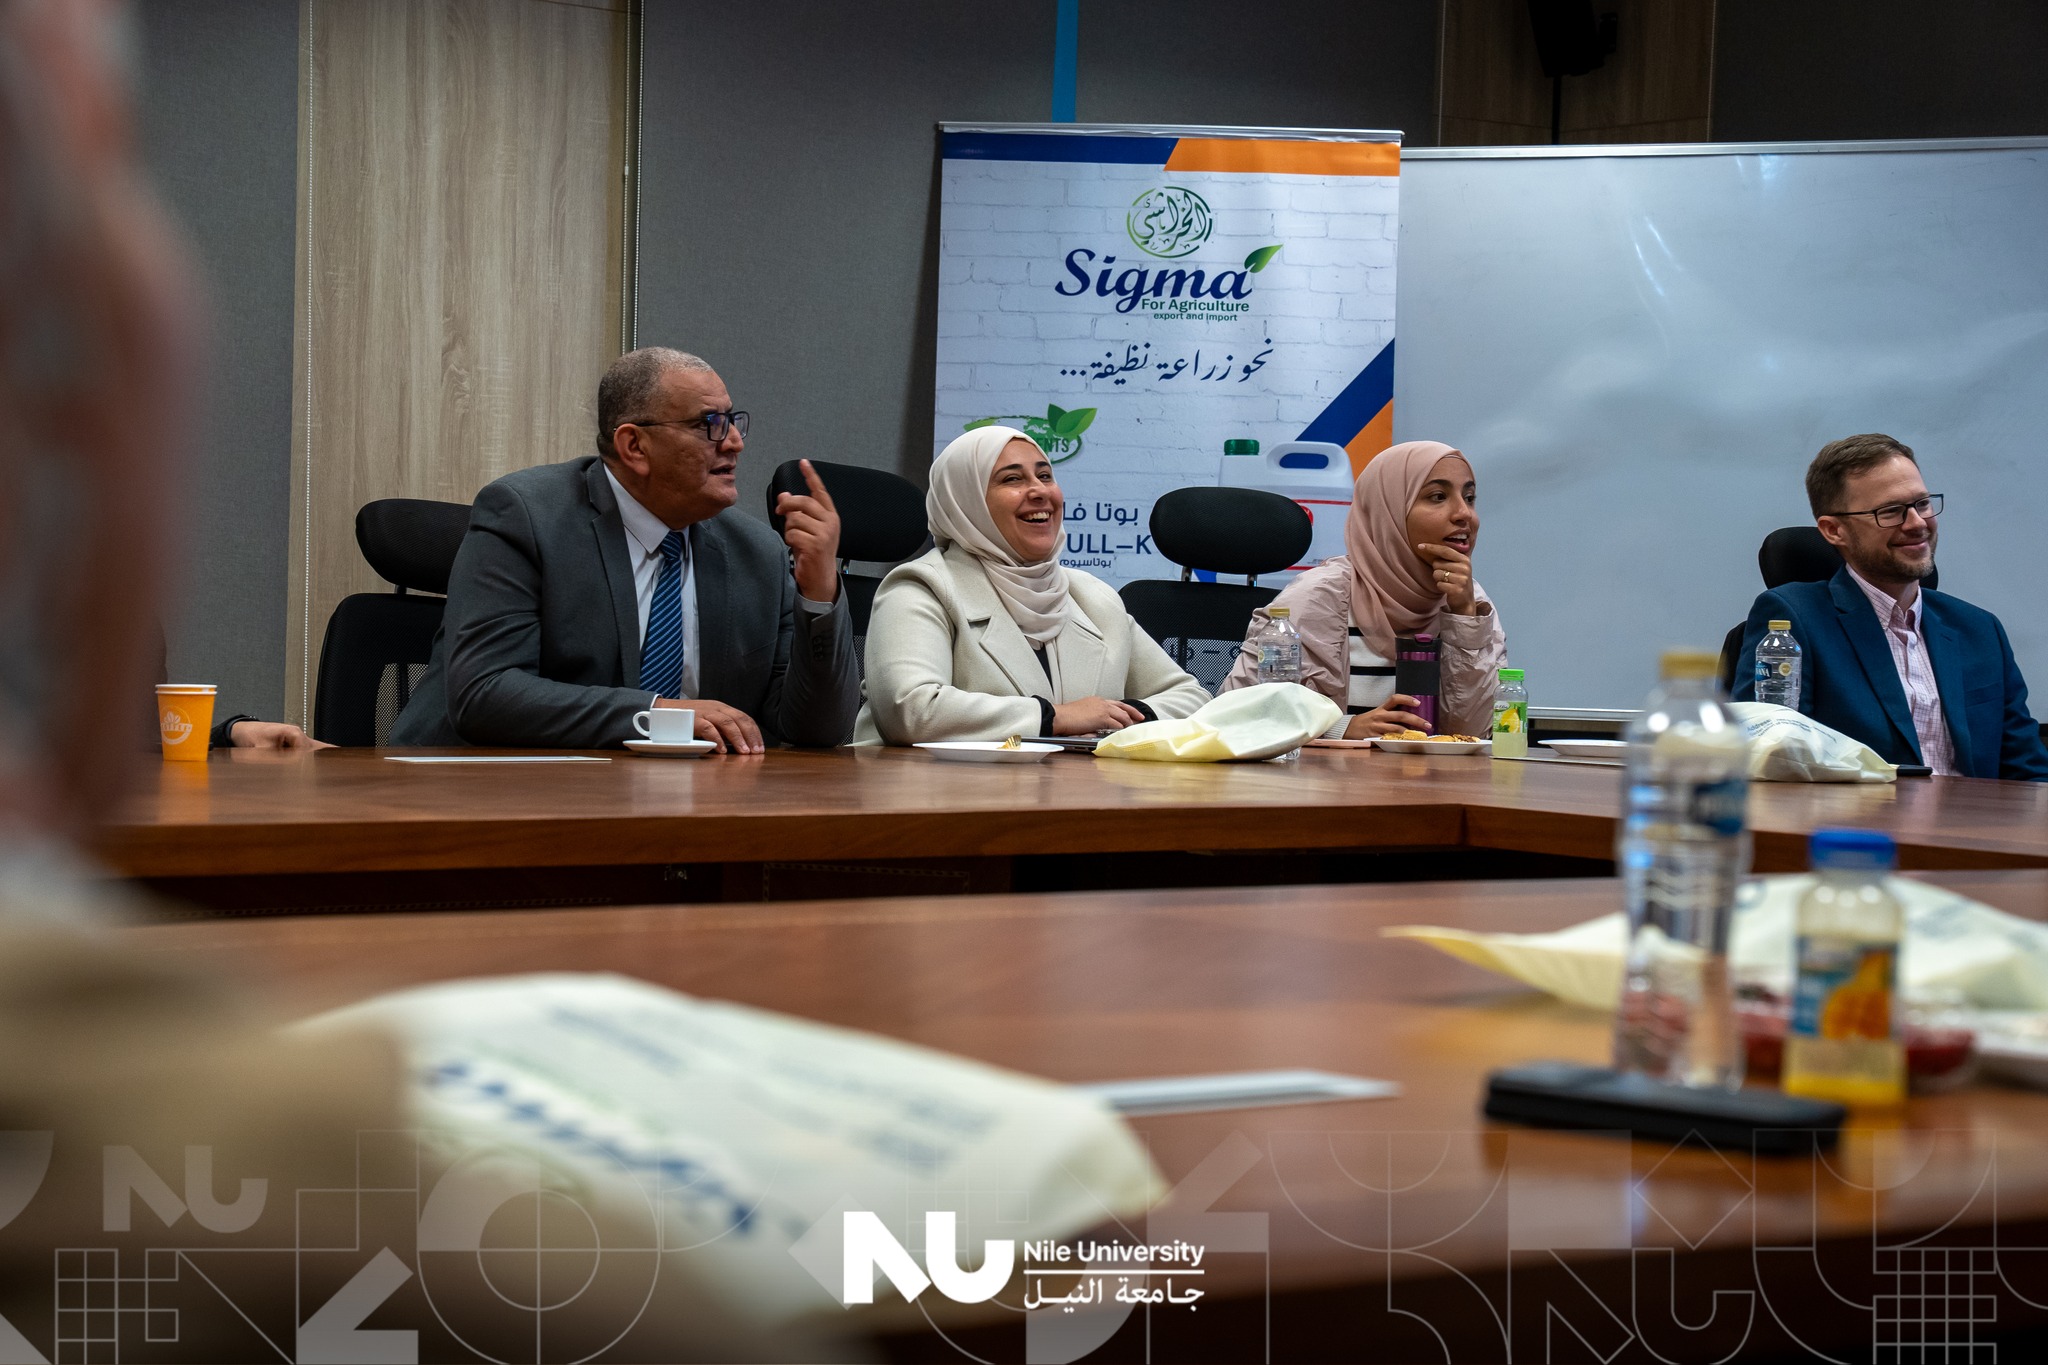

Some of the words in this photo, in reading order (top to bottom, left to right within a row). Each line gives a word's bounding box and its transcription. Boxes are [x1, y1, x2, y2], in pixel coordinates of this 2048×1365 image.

[1054, 248, 1253, 314] Sigma
[1141, 298, 1166, 311] For
[1169, 299, 1250, 313] Agriculture
[1153, 313, 1184, 322] export
[1185, 312, 1204, 321] and
[1205, 313, 1238, 322] import
[1156, 348, 1234, 382] زراعة
[1237, 338, 1275, 383] نحو
[1096, 502, 1139, 527] بوتا
[1066, 532, 1152, 555] ULL-K
[1060, 557, 1112, 569] بوتاسيوم
